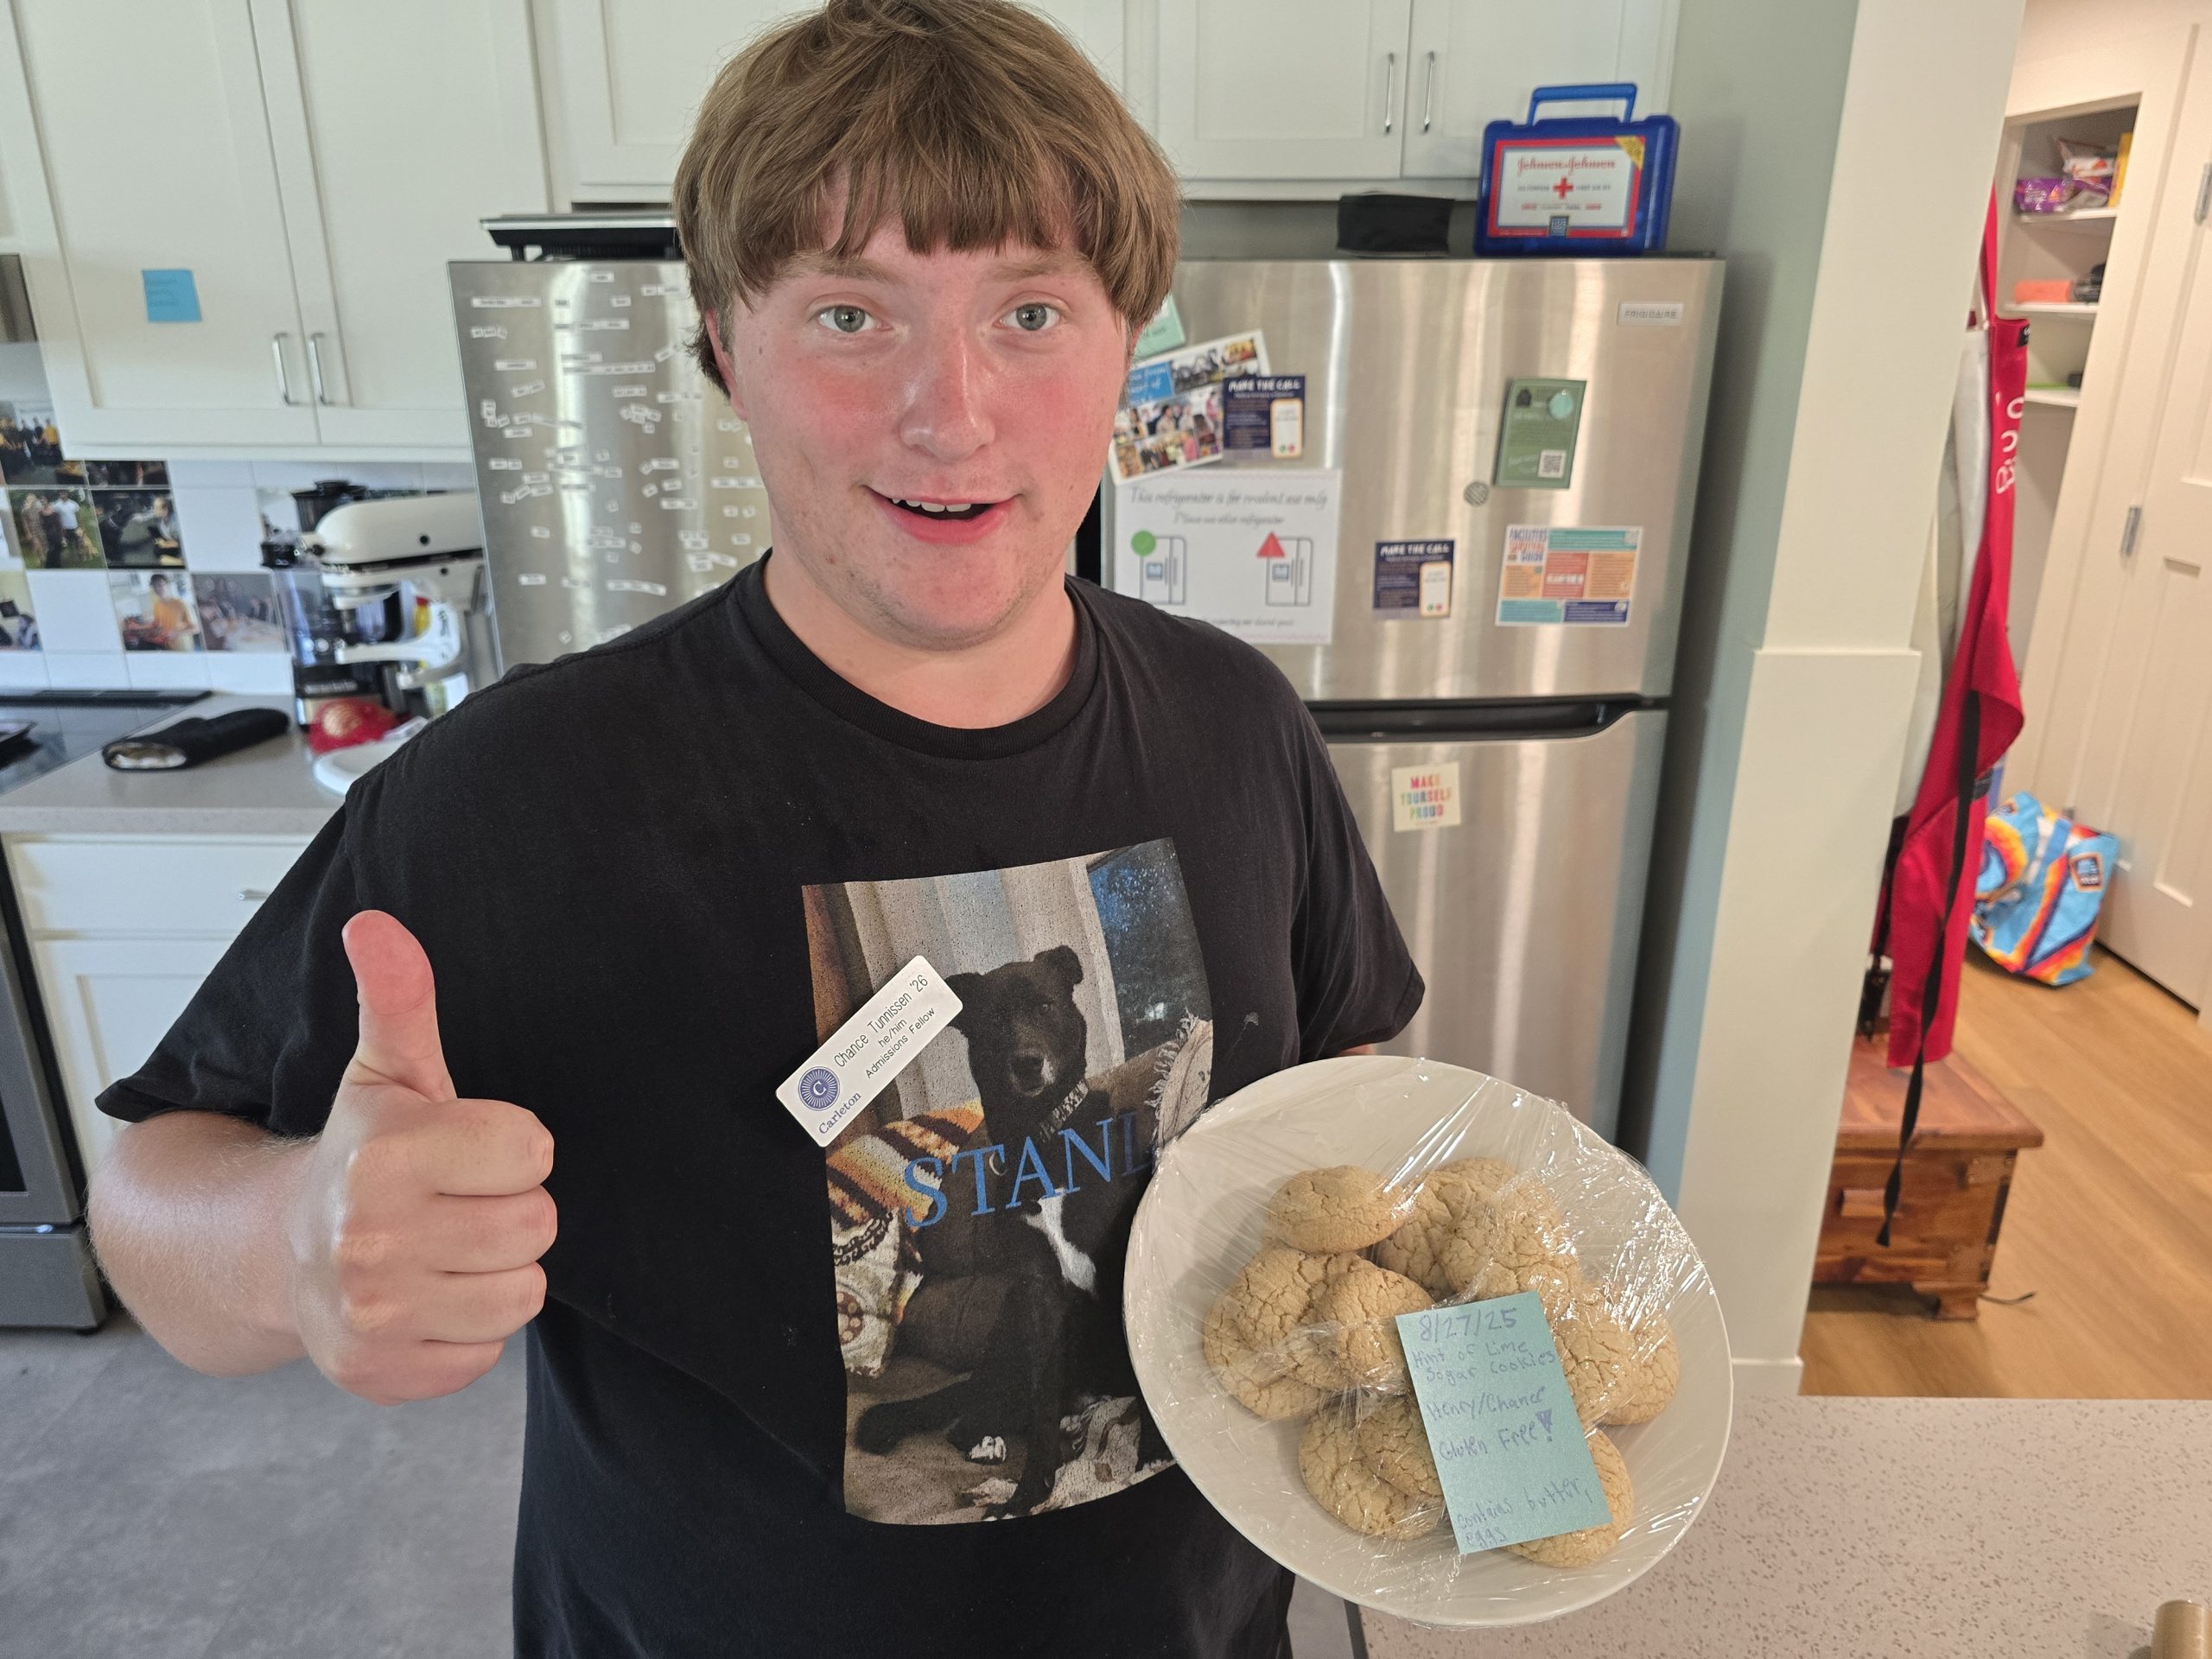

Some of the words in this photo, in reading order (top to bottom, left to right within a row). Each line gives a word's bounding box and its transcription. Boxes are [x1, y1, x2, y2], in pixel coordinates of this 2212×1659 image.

[1624, 308, 1677, 319] FRIGIDAIRE
[1410, 773, 1441, 789] MAKE
[1401, 786, 1452, 806] YOURSELF
[1410, 804, 1444, 820] PROUD
[834, 1033, 869, 1068] Chance
[867, 991, 912, 1033] Tunnissen
[909, 974, 929, 993] '26
[878, 1018, 907, 1048] he/him
[866, 1034, 908, 1079] Admissions
[908, 1007, 936, 1035] Fellow
[818, 1092, 862, 1135] Carleton
[1419, 1307, 1517, 1343] 8/27/25
[1411, 1348, 1446, 1369] Hint
[1484, 1340, 1529, 1357] Lime
[1439, 1435, 1488, 1460] Gluten
